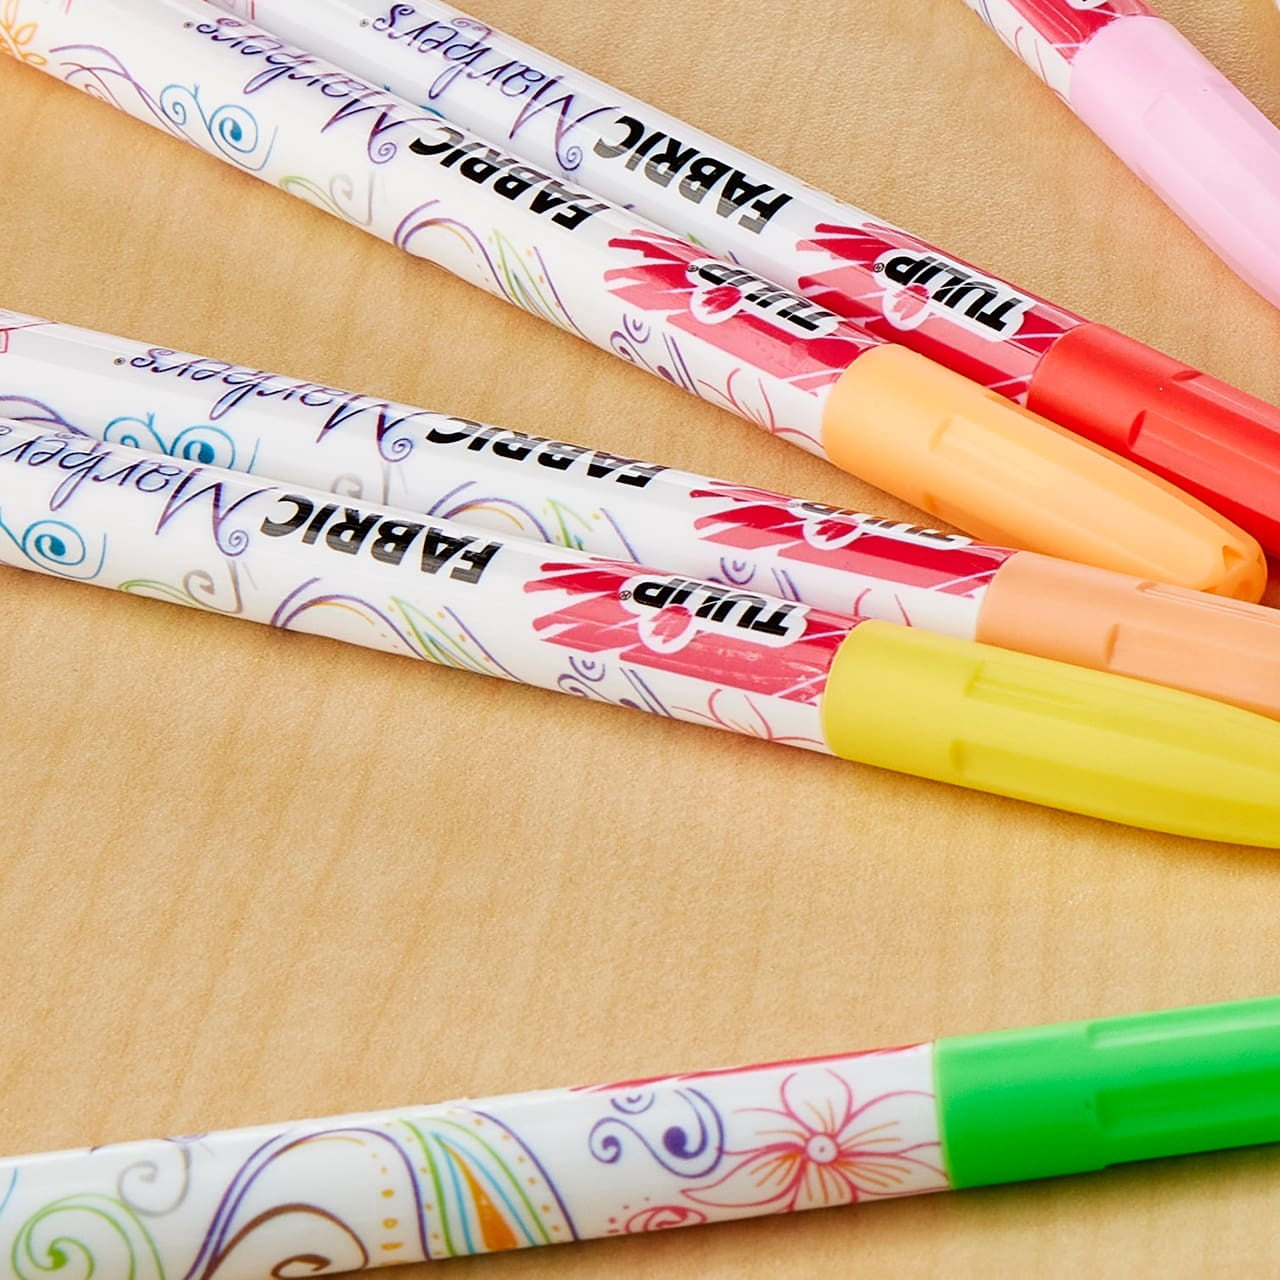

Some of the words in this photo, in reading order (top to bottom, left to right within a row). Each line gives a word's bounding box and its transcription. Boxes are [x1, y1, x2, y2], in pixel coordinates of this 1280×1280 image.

[196, 18, 440, 163] Markers
[373, 3, 621, 171] Markers
[409, 125, 613, 230] FABRIC
[592, 115, 794, 234] FABRIC
[698, 261, 831, 331] TULIP
[884, 254, 1025, 331] TULIP
[130, 347, 443, 460] Markers
[426, 418, 669, 488] FABRIC
[0, 424, 280, 557] Marker
[260, 493, 505, 585] FABRIC
[633, 577, 798, 638] TULIP
